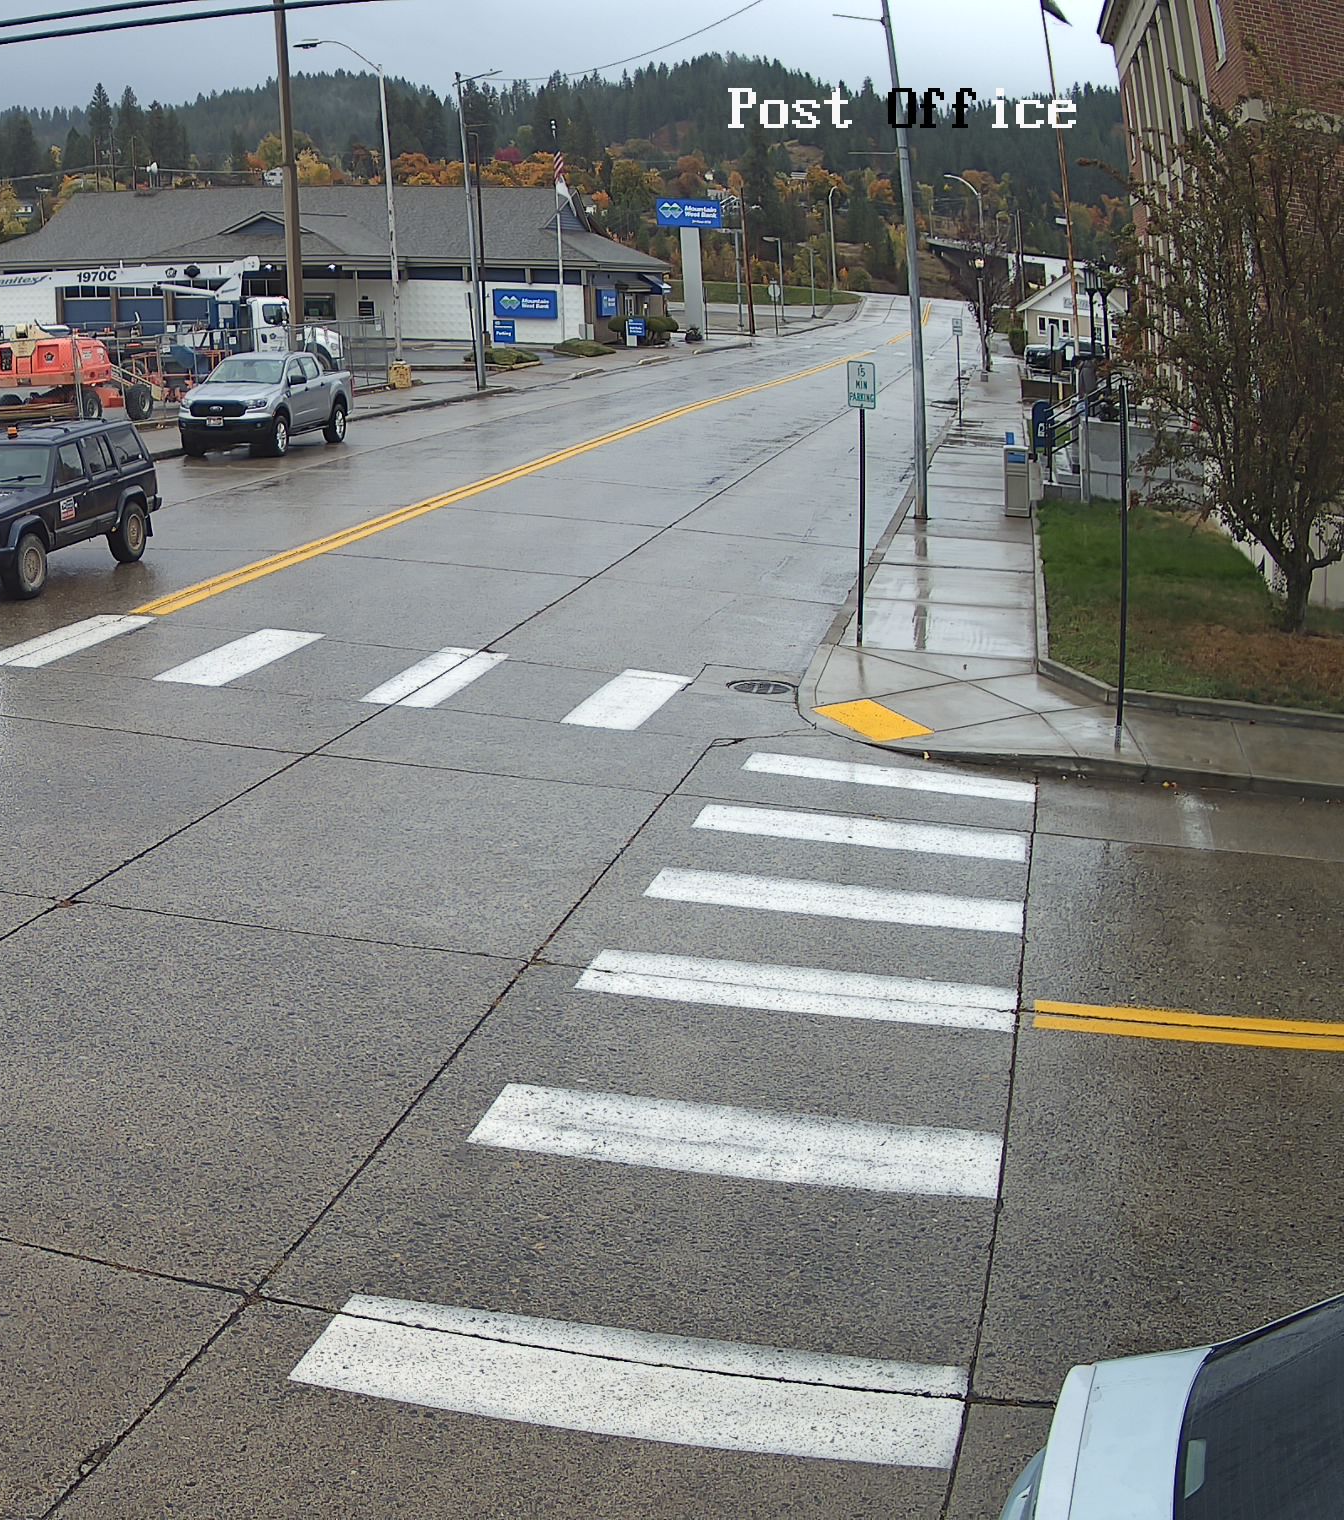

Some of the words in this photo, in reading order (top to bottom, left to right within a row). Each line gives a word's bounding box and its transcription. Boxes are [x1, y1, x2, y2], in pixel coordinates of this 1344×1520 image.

[684, 205, 717, 213] Mountain
[76, 270, 117, 284] 1970C
[857, 367, 866, 378] 15
[855, 380, 868, 390] MIN
[849, 391, 875, 403] PARKING
